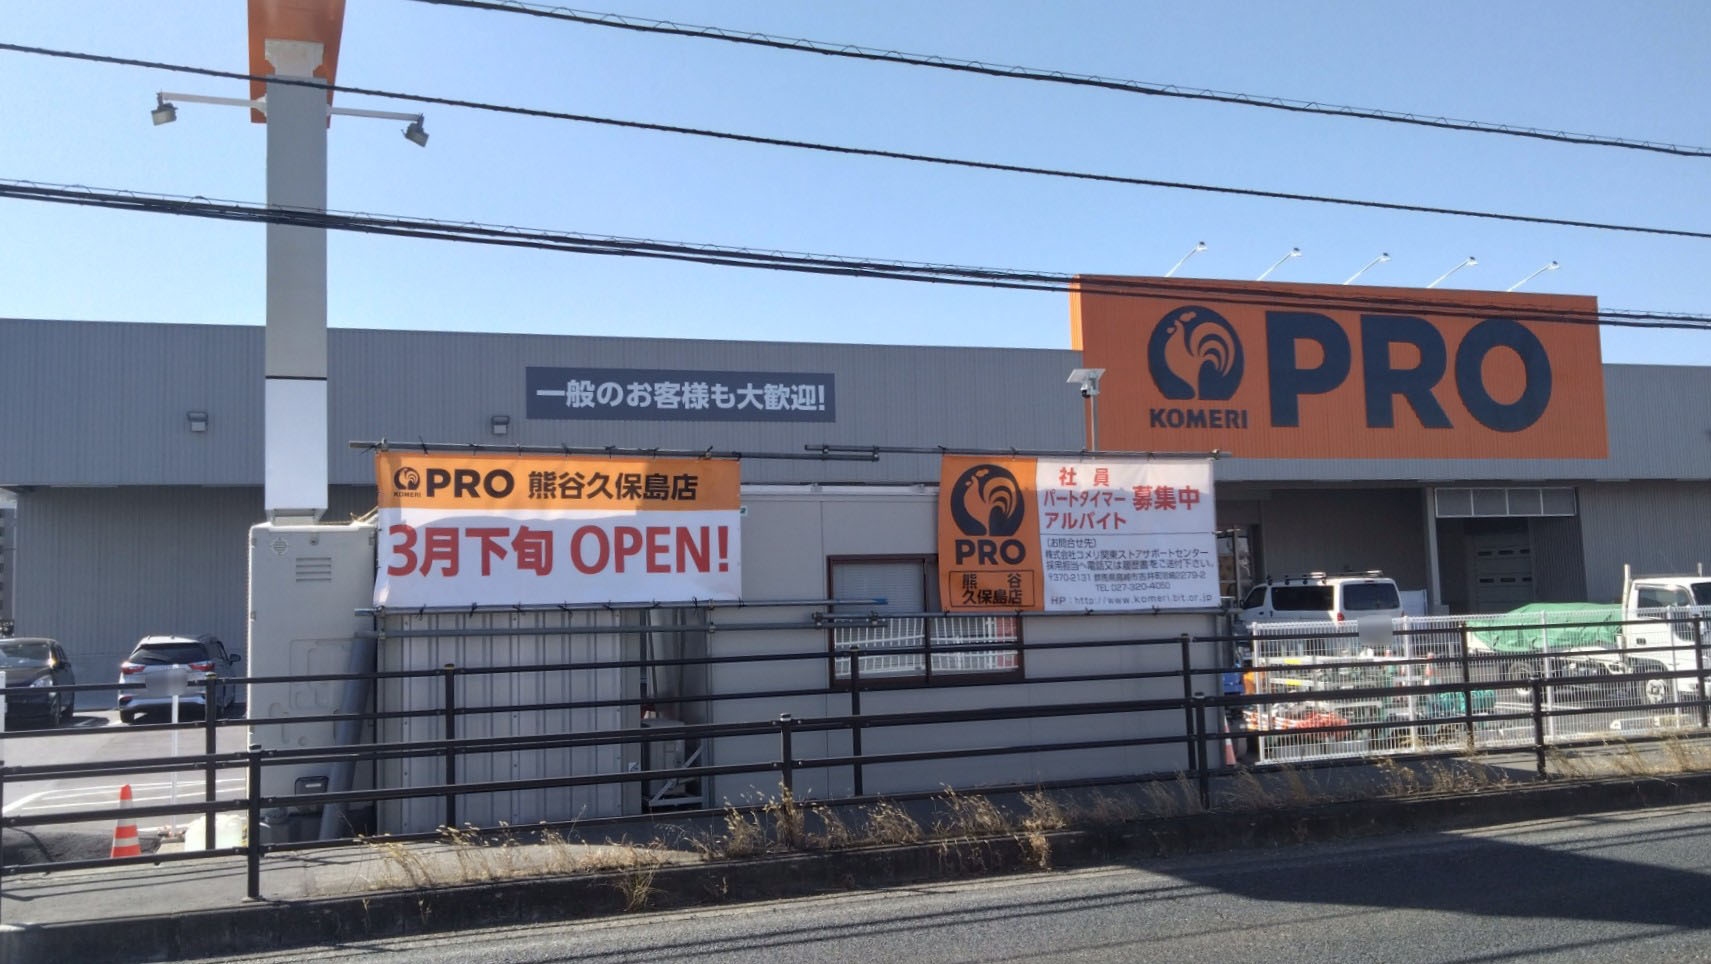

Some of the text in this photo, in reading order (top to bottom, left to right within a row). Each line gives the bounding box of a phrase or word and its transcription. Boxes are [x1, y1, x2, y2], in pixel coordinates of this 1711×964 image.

[1264, 310, 1553, 434] PRO
[1149, 408, 1248, 429] KOMERI
[426, 468, 515, 499] PRO
[528, 471, 699, 501] 熊谷久保島店
[1043, 488, 1126, 508] パートタイマー
[1132, 485, 1201, 511] 募集中
[1044, 511, 1127, 530] アルバイト
[386, 524, 729, 577] 3月下旬 OPEN!
[955, 539, 1026, 565] PRO
[962, 589, 1023, 605] 久保島店
